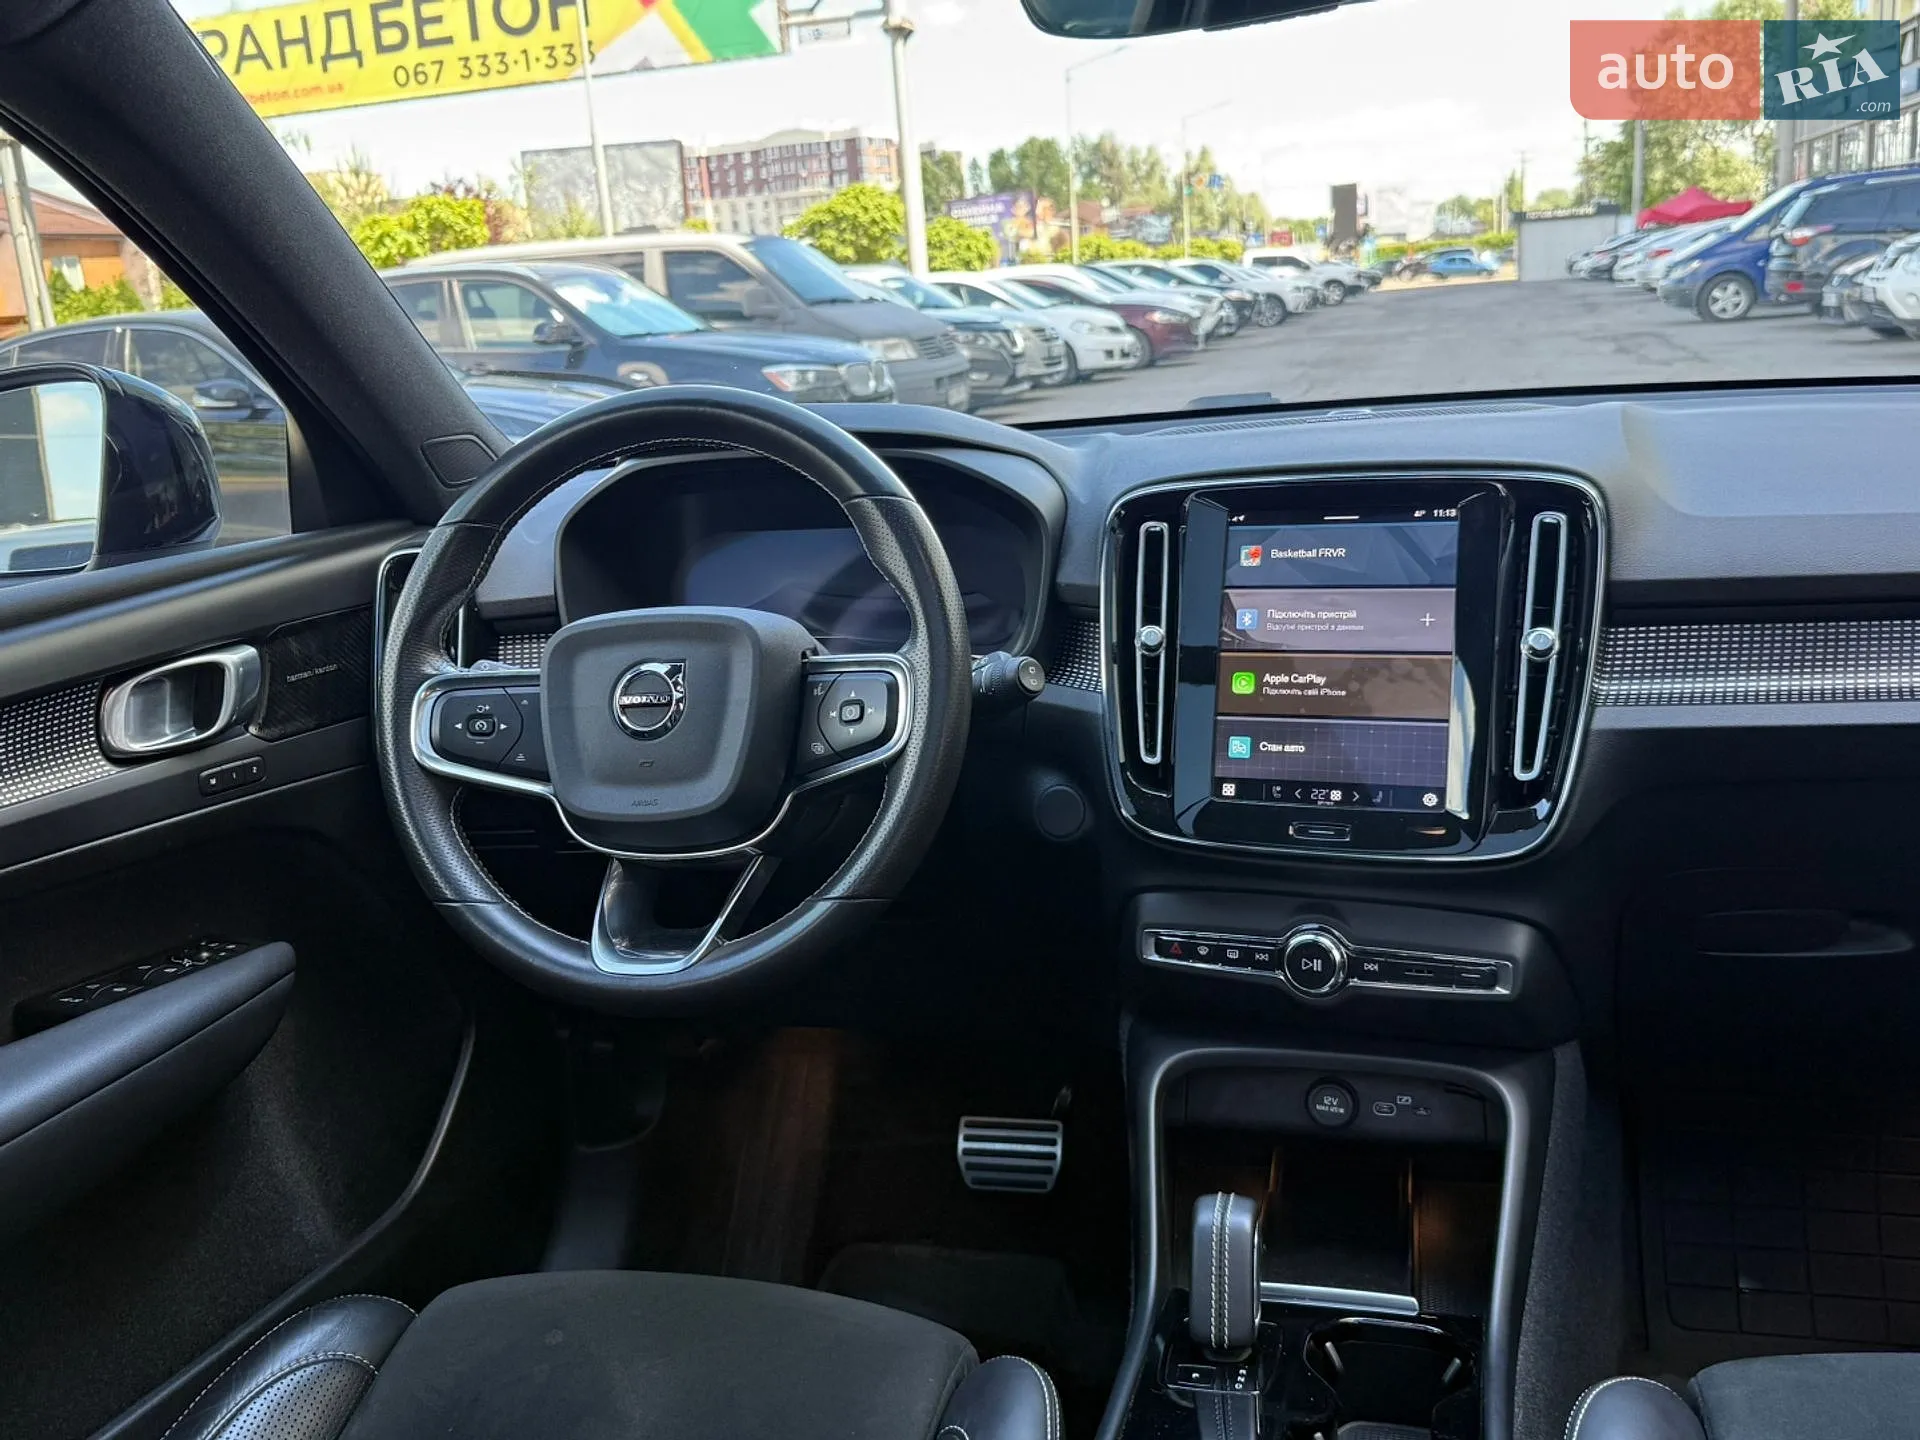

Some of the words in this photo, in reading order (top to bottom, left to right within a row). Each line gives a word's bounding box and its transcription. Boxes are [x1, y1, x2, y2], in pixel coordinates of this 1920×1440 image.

[393, 60, 444, 88] 067
[1270, 548, 1317, 559] Basketball
[1318, 547, 1346, 558] FRVR
[1262, 672, 1290, 685] Apple
[1290, 673, 1327, 687] CarPlay
[619, 695, 671, 704] VOLVO
[1259, 741, 1283, 752] Стан
[1284, 744, 1306, 752] авто
